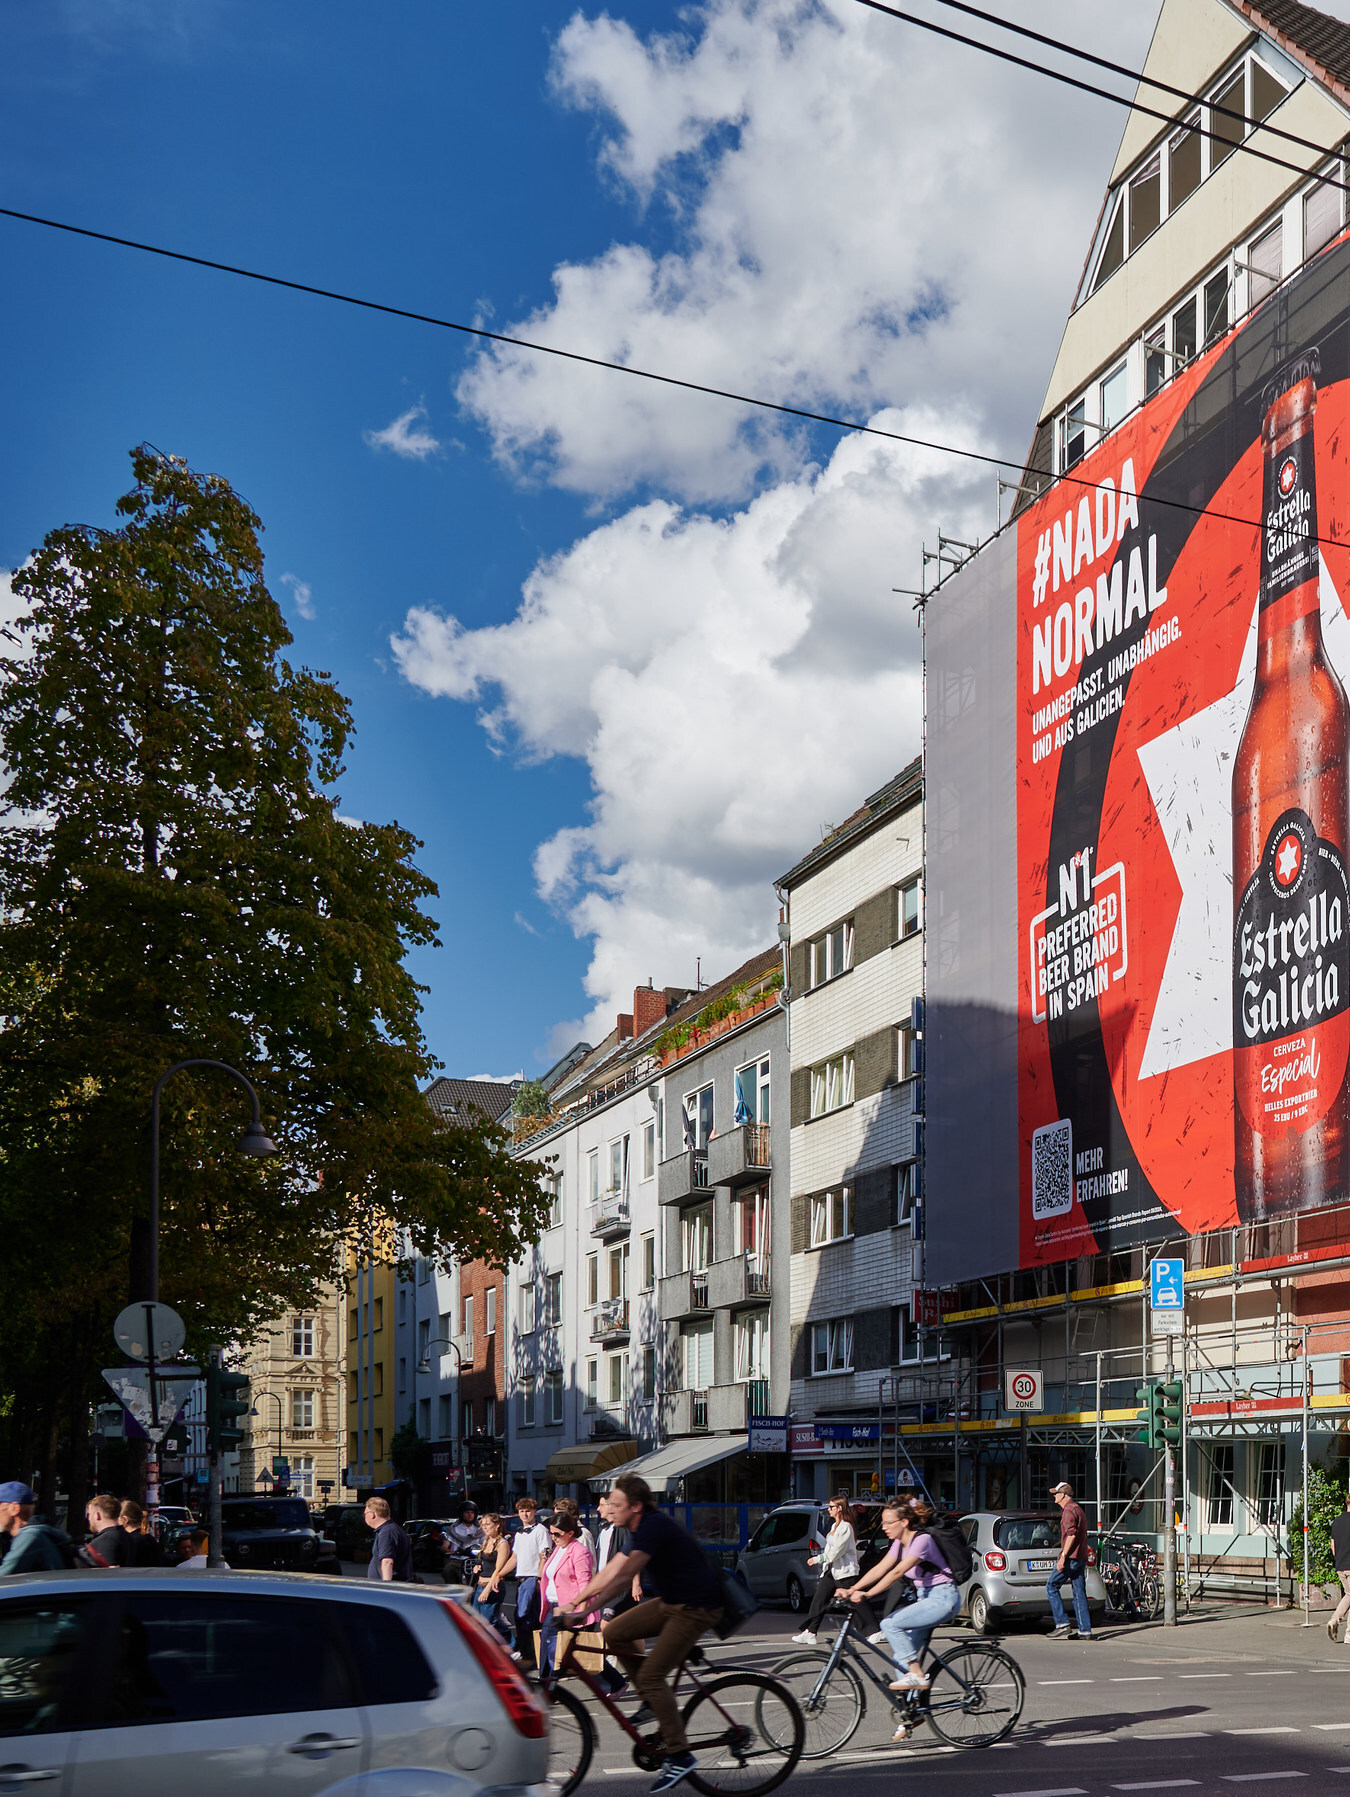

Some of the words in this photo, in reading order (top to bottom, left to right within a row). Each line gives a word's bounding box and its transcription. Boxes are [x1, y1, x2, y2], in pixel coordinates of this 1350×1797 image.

[1032, 457, 1139, 608] #NADA
[1266, 488, 1311, 538] Estrella
[1267, 515, 1310, 562] Galicia
[1032, 533, 1168, 695] NORMAL
[1032, 667, 1105, 735] UNANGEPASST.
[1108, 616, 1182, 684] UNABHÄNGIG.
[1032, 733, 1052, 764] UND
[1054, 718, 1074, 750] AUS
[1076, 685, 1126, 735] GALICIEN.
[1038, 892, 1117, 967] PREFERRED
[1239, 889, 1343, 978] Estrella
[1039, 954, 1070, 996] BEER
[1073, 925, 1118, 976] BRAND
[1049, 988, 1063, 1021] IN
[1067, 962, 1109, 1011] SPAIN
[1242, 955, 1340, 1038] Galicia
[1260, 1037, 1321, 1094] Especial
[1273, 1037, 1306, 1057] CERVEZA
[1264, 1100, 1284, 1112] HELLES
[1284, 1089, 1318, 1107] EXPORTBIER
[1076, 1147, 1104, 1175] MEHR
[1076, 1168, 1128, 1203] ERFAHREN!
[1156, 1262, 1170, 1282] P
[1287, 1253, 1303, 1263] Layher
[918, 1294, 955, 1309] Suhi
[1015, 1400, 1034, 1408] ZONE
[1017, 1380, 1032, 1393] 30
[1235, 1402, 1251, 1410] Layher
[796, 1432, 815, 1443] SUSHI-B
